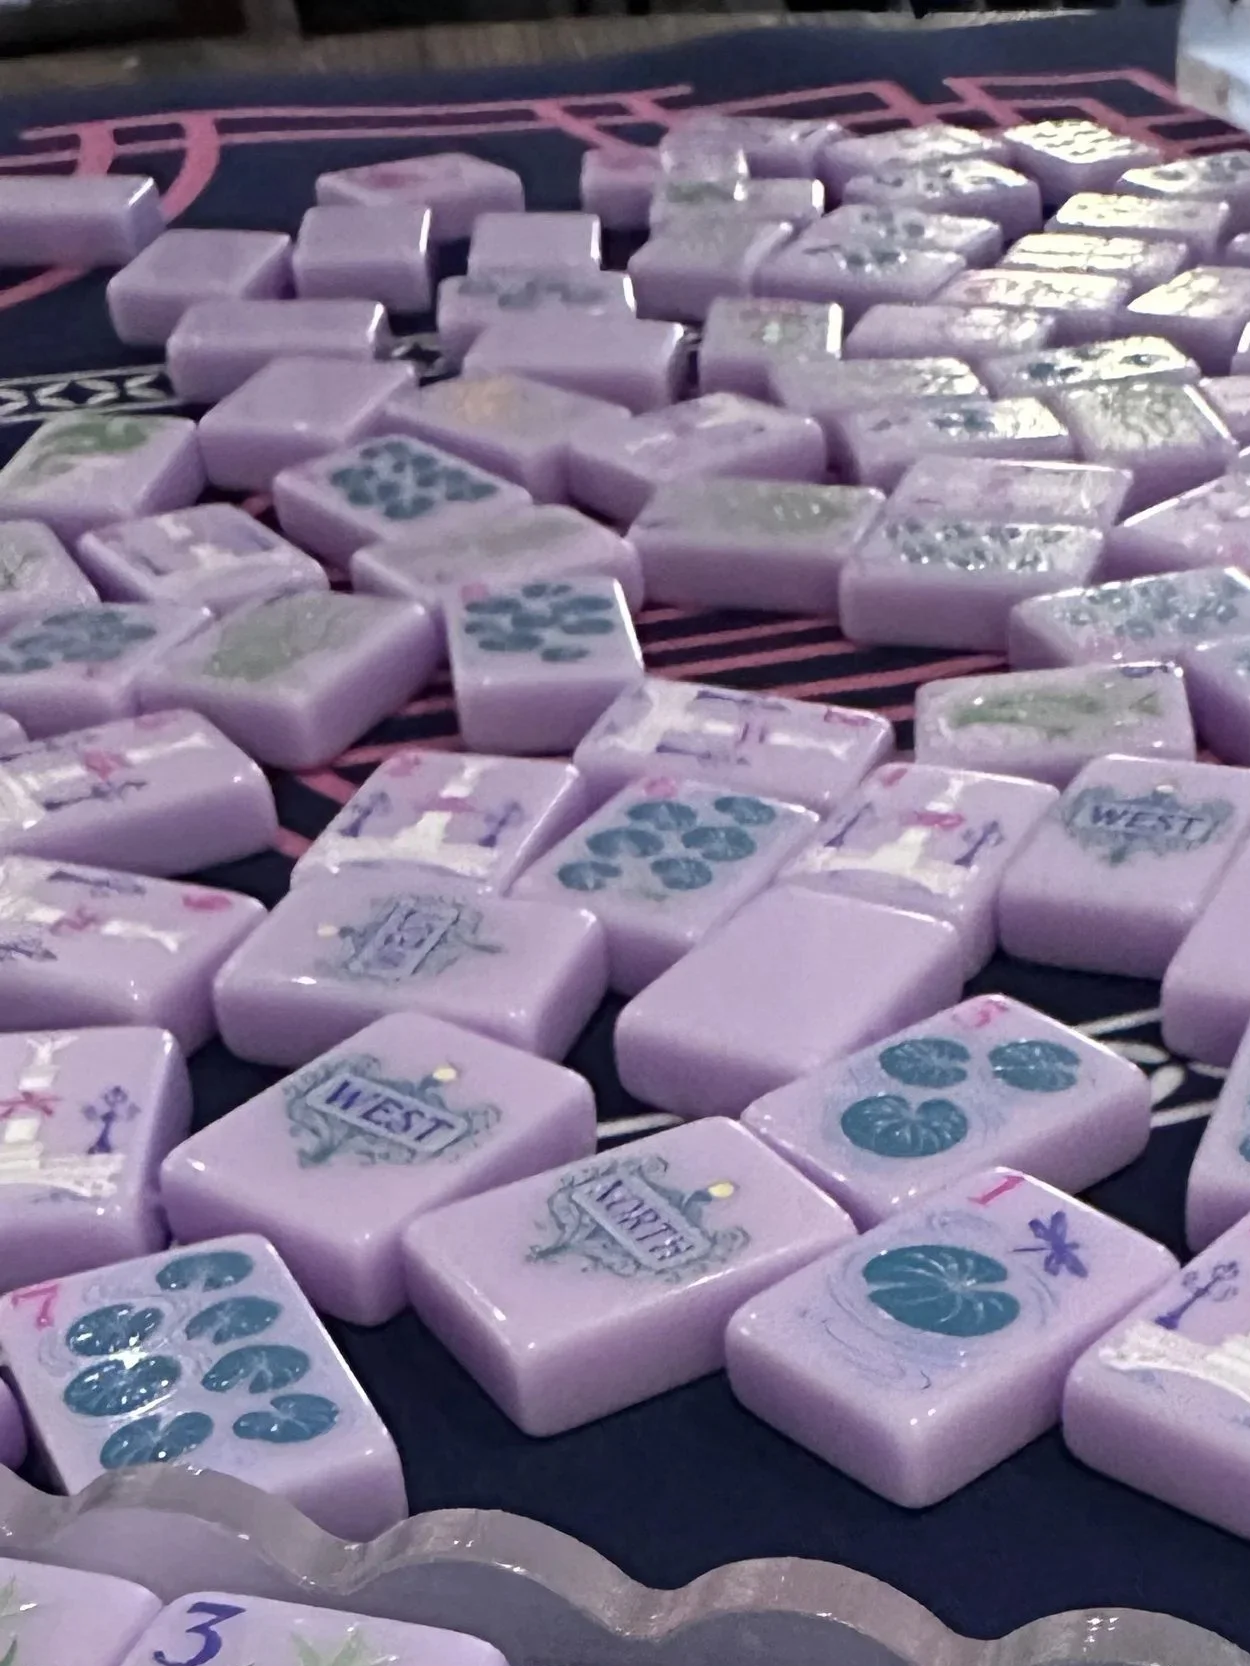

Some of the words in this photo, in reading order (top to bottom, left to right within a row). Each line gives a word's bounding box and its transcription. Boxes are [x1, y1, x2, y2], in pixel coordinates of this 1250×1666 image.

[1092, 804, 1204, 835] WEST
[324, 1078, 455, 1145] WEST
[968, 1175, 1025, 1207] 1
[596, 1179, 695, 1261] NORTH
[11, 1284, 59, 1329] 7
